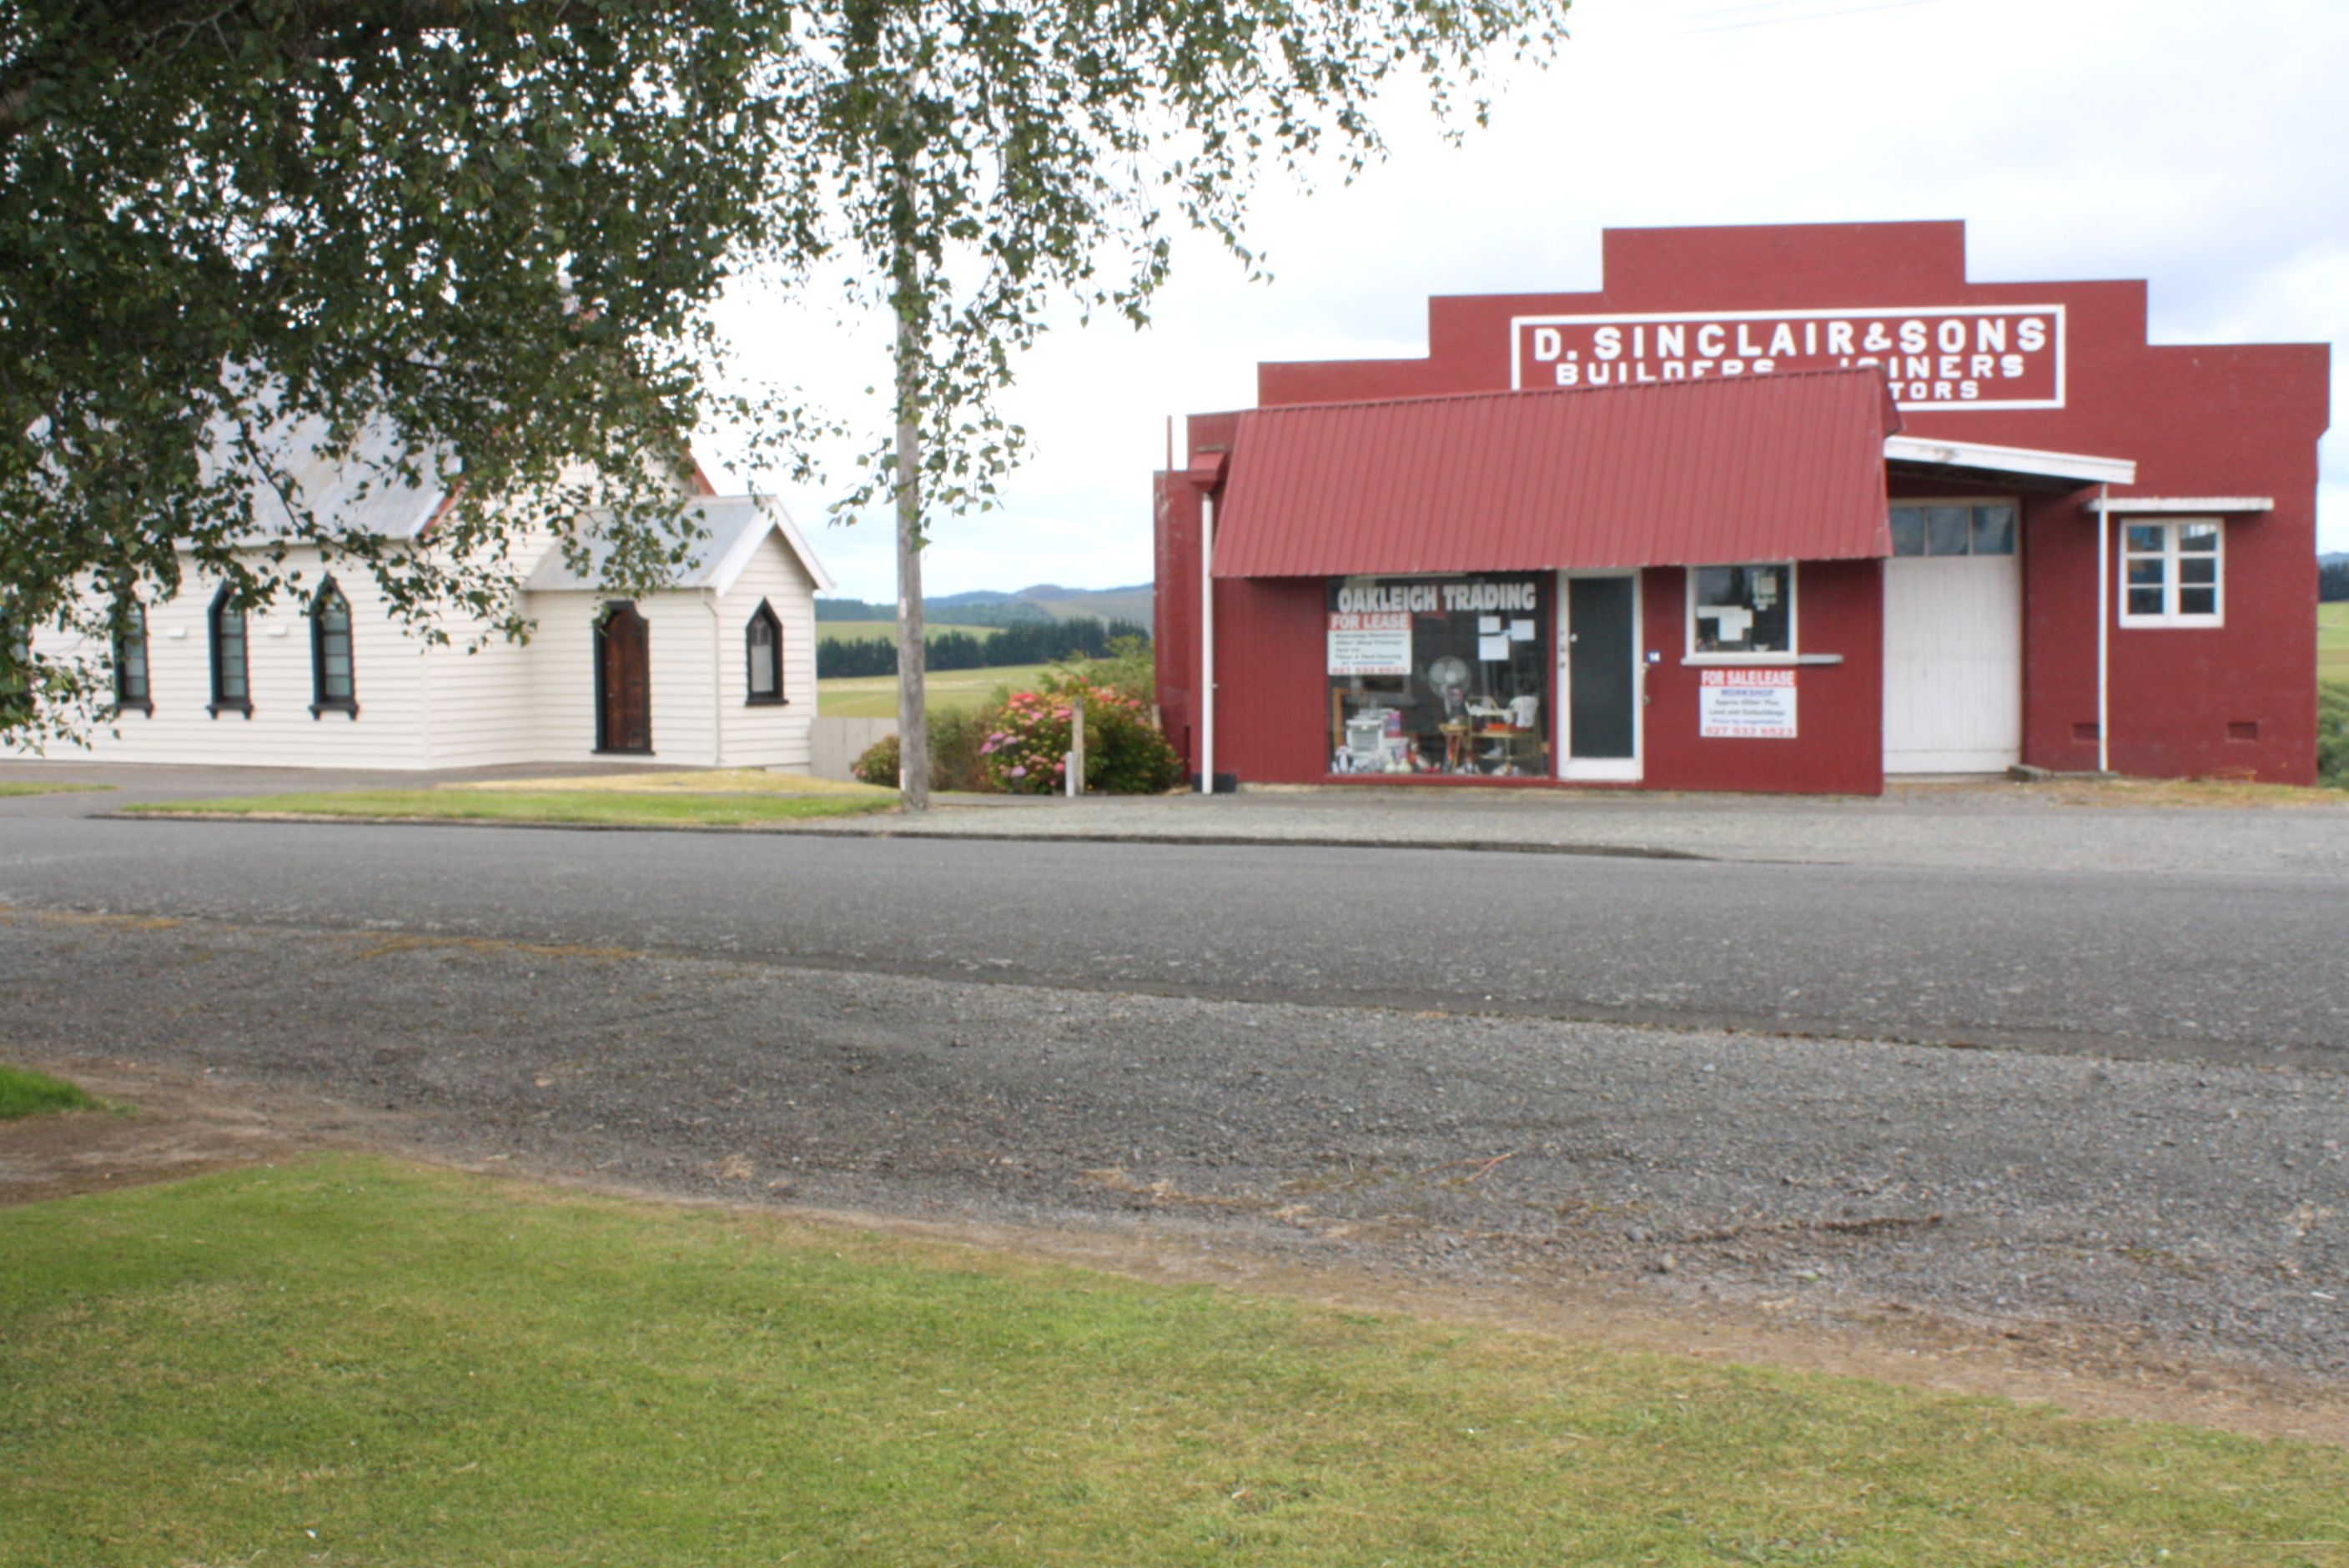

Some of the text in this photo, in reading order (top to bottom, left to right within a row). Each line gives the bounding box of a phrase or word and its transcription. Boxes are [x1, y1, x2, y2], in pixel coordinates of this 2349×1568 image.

[1535, 328, 1577, 361] D.
[1338, 583, 1536, 612] OAKLEIGH TRADING
[1332, 613, 1409, 629] FOR LEASE
[1702, 670, 1725, 686] FOR
